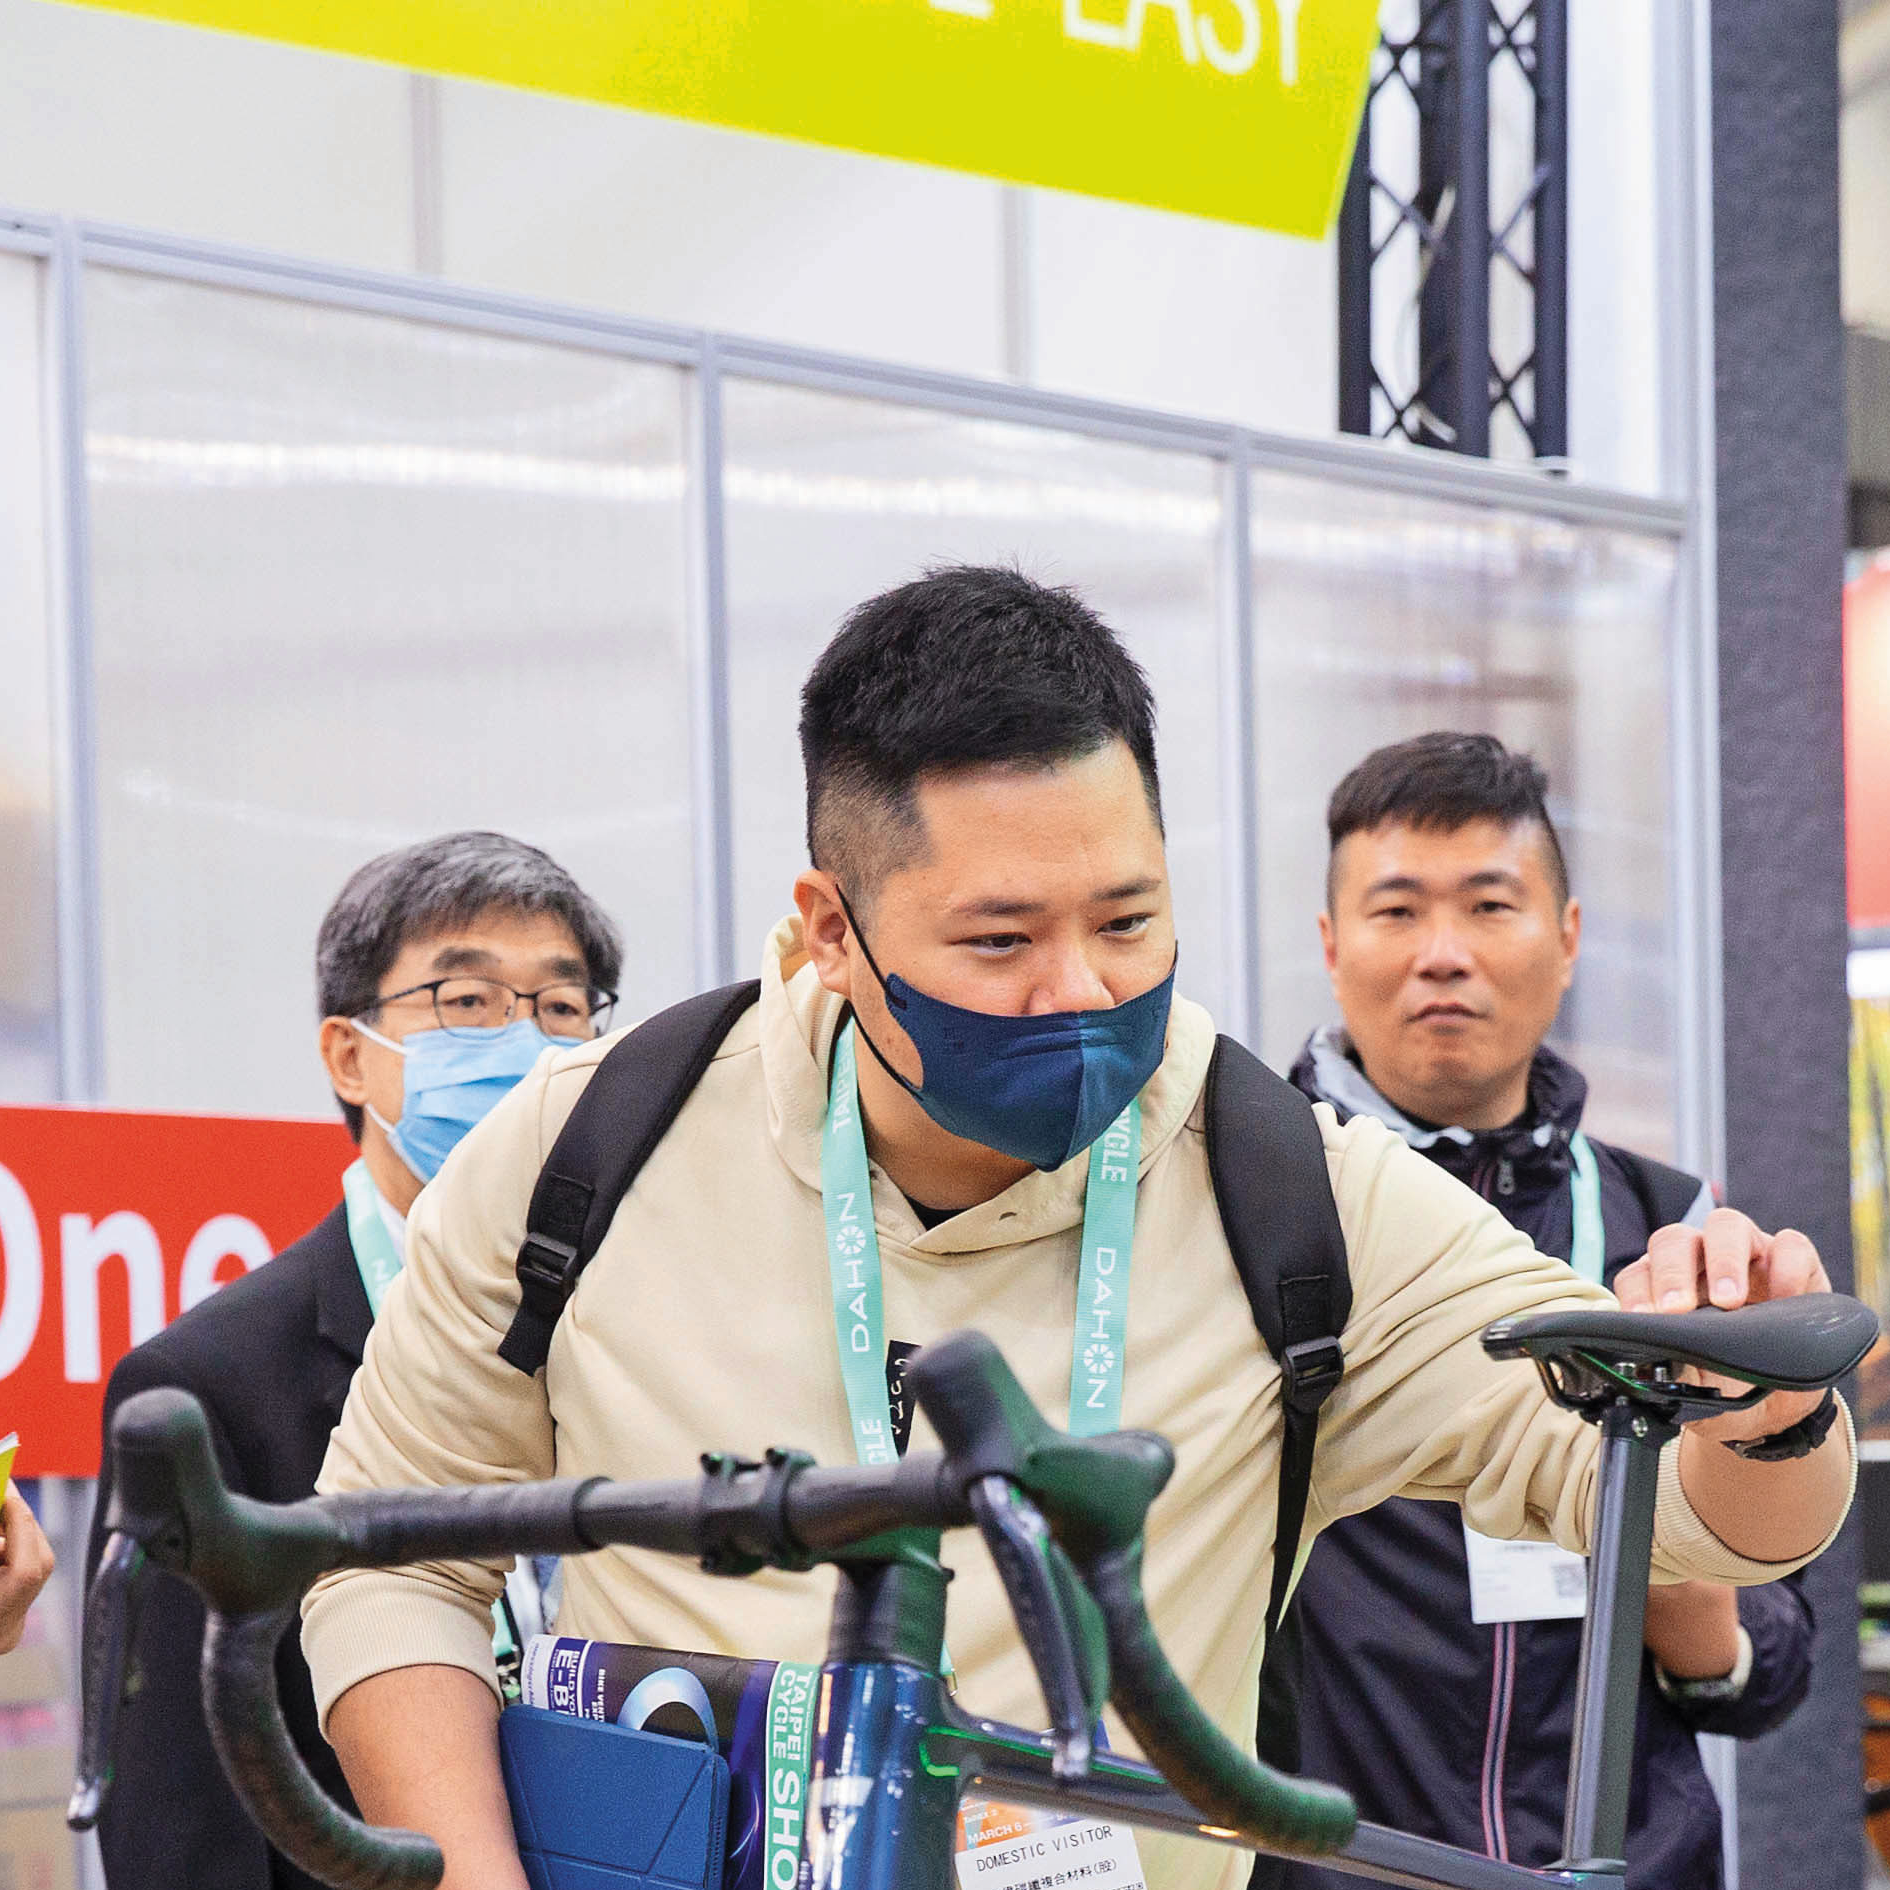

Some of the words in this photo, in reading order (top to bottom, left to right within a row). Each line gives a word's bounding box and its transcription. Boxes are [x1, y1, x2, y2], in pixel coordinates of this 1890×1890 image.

[1100, 1106, 1131, 1183] YCLE
[836, 1192, 872, 1353] DAHON
[1083, 1247, 1118, 1410] DAHON
[787, 1671, 813, 1761] TAIPEI
[967, 1825, 1013, 1845] MARCH
[976, 1843, 1046, 1872] DOMESTIC
[1051, 1825, 1113, 1852] VISITOR
